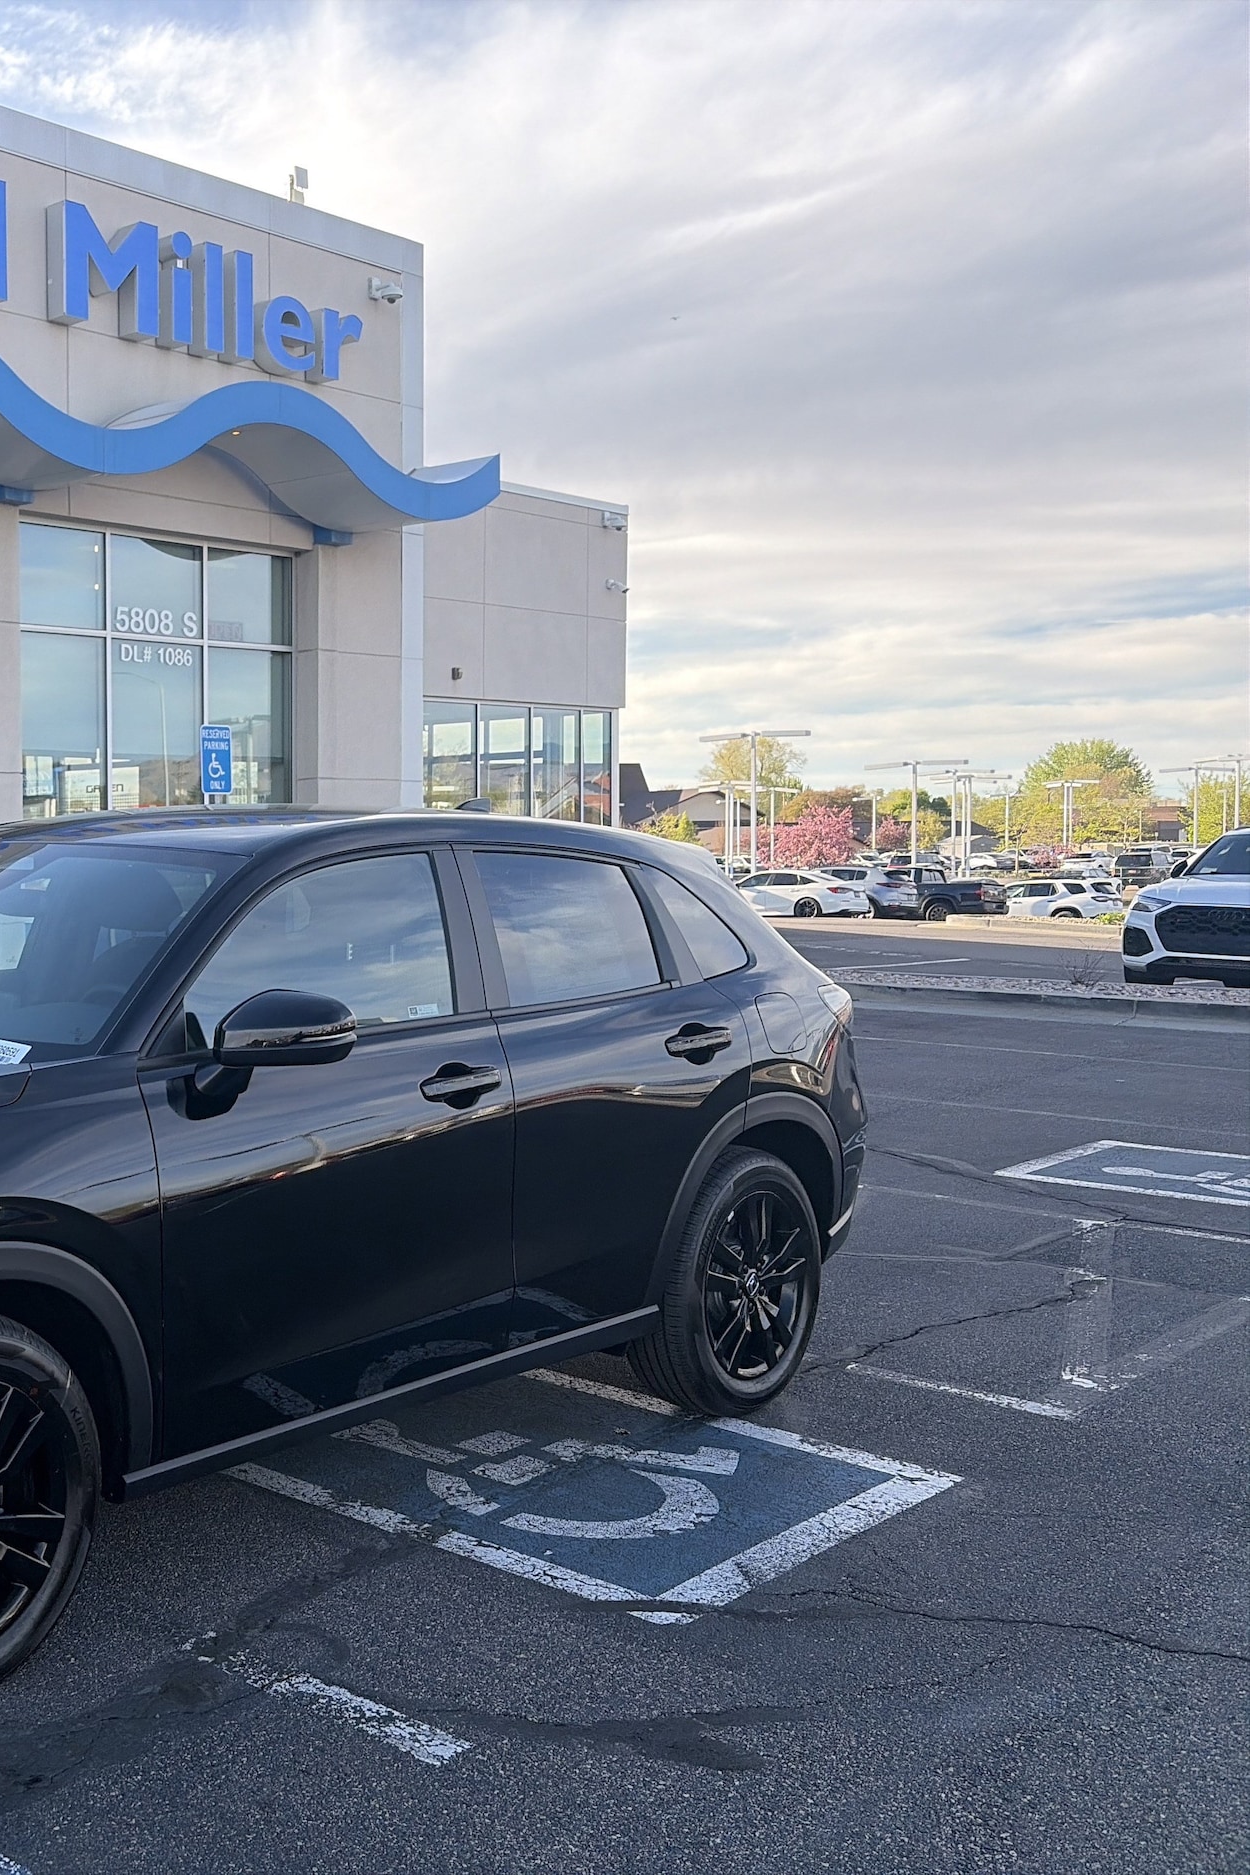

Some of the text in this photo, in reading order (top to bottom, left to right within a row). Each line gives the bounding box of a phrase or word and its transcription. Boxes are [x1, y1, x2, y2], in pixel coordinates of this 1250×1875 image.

[47, 200, 363, 382] Miller
[116, 606, 198, 637] 5808 S
[121, 643, 193, 666] DL# 1086
[202, 729, 230, 739] RESERVED
[203, 741, 229, 751] PARKING
[209, 781, 226, 790] ONLY
